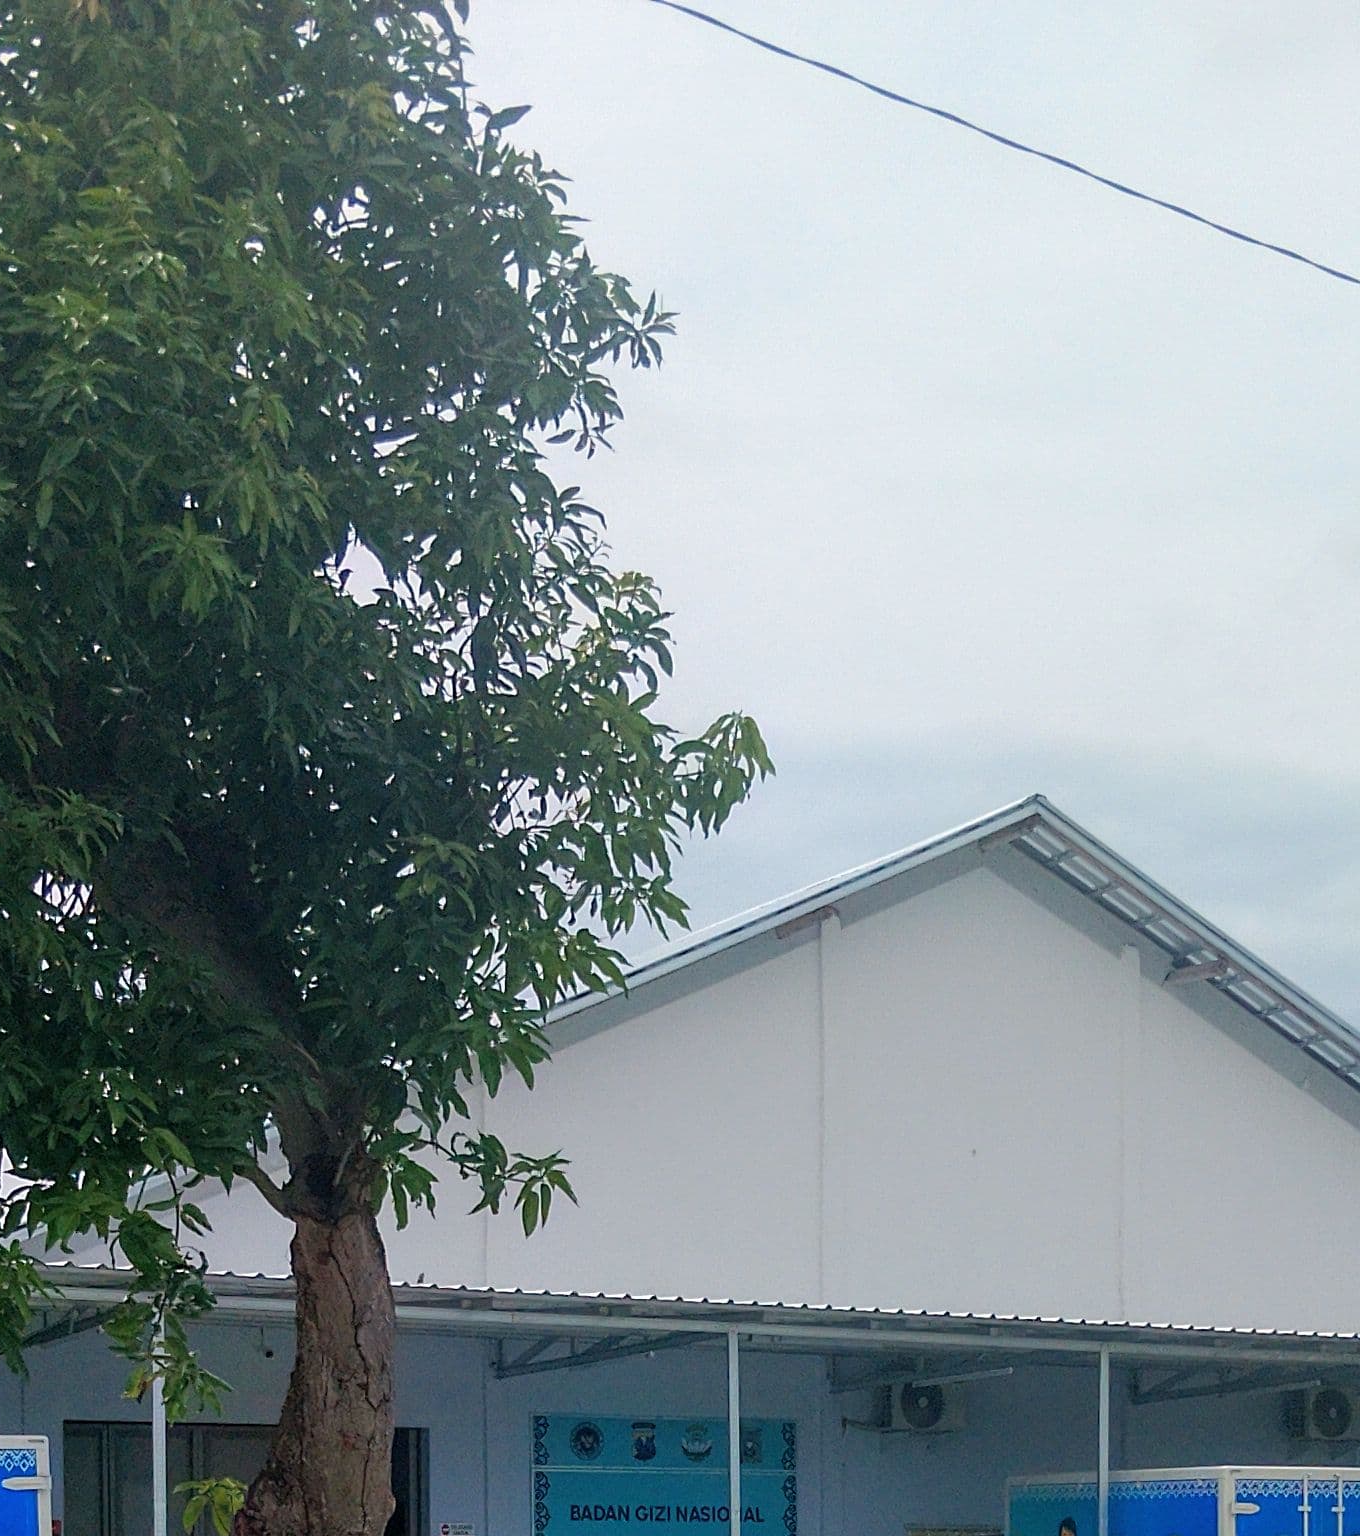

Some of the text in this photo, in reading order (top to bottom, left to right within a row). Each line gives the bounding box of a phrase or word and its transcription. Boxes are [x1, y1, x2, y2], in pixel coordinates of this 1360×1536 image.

[570, 1505, 765, 1523] BADAN GIZI NASIOAL
